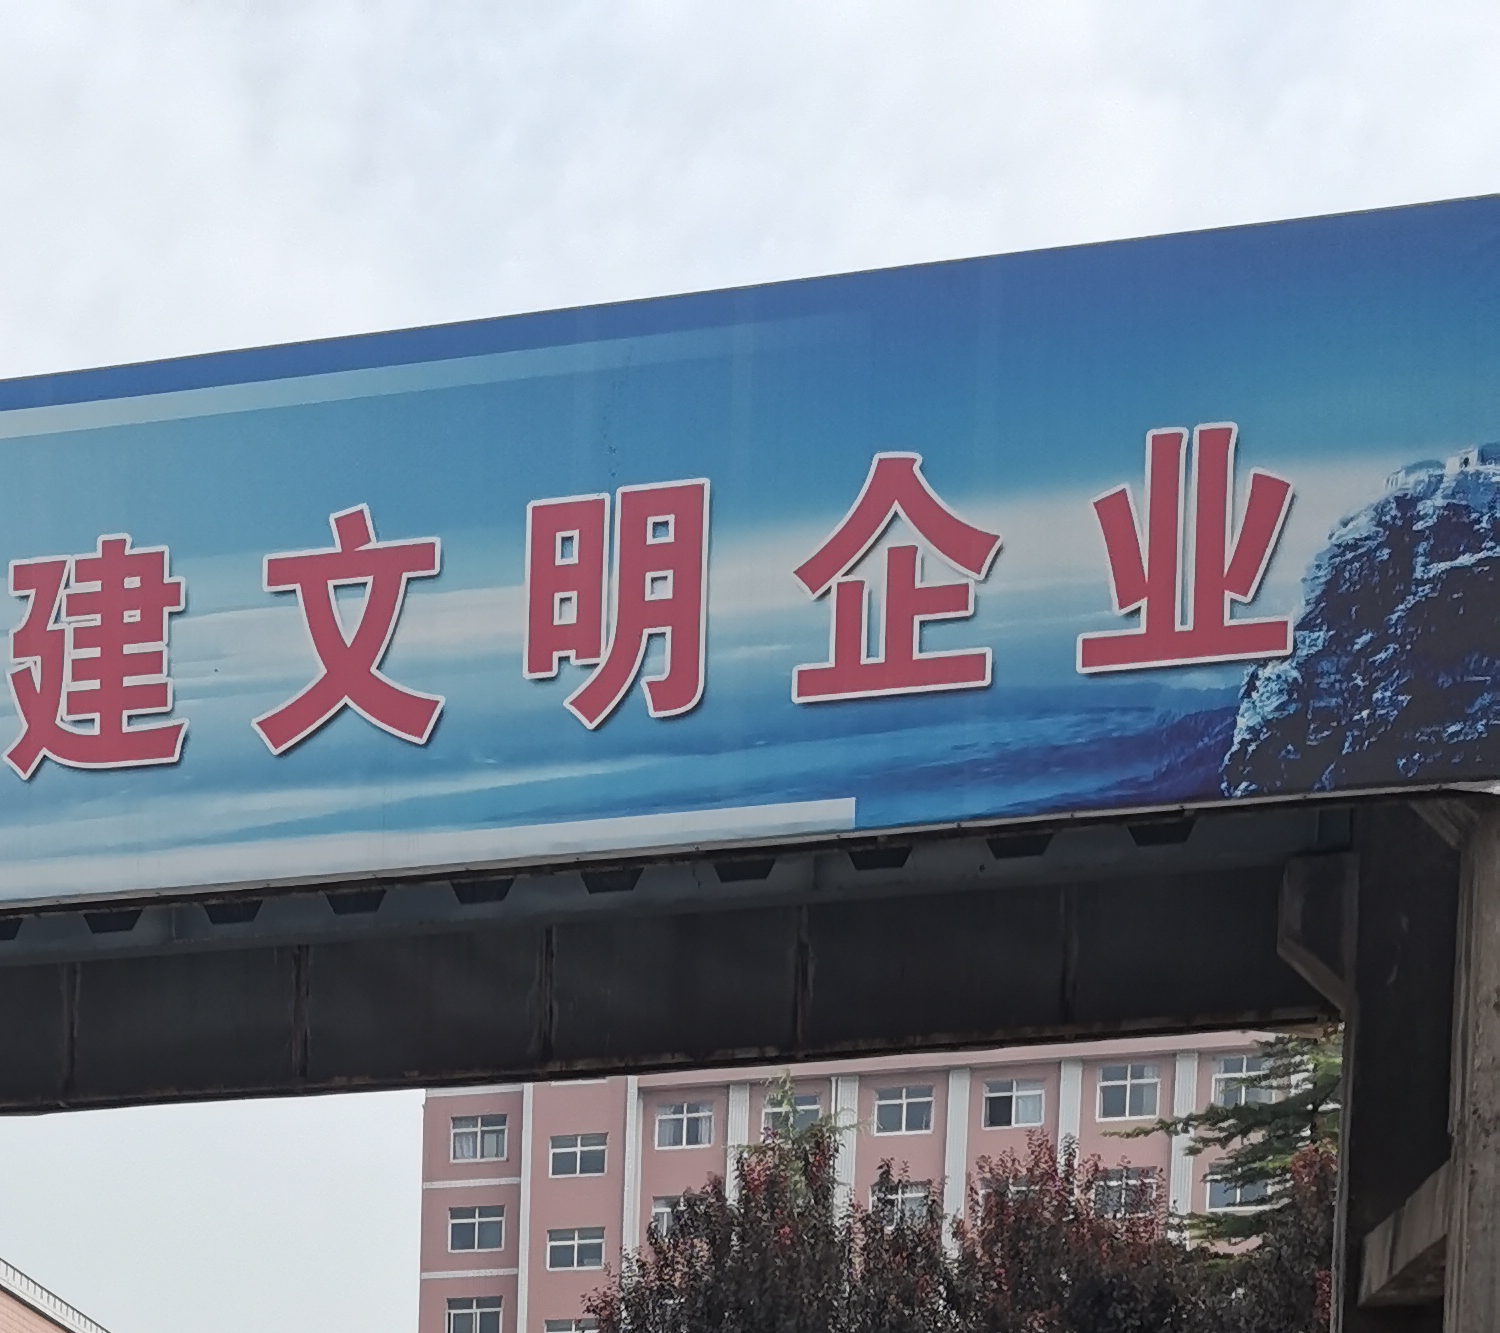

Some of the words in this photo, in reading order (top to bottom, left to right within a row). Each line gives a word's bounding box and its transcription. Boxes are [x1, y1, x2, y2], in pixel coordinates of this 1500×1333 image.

[2, 420, 1296, 780] 建文明企业
